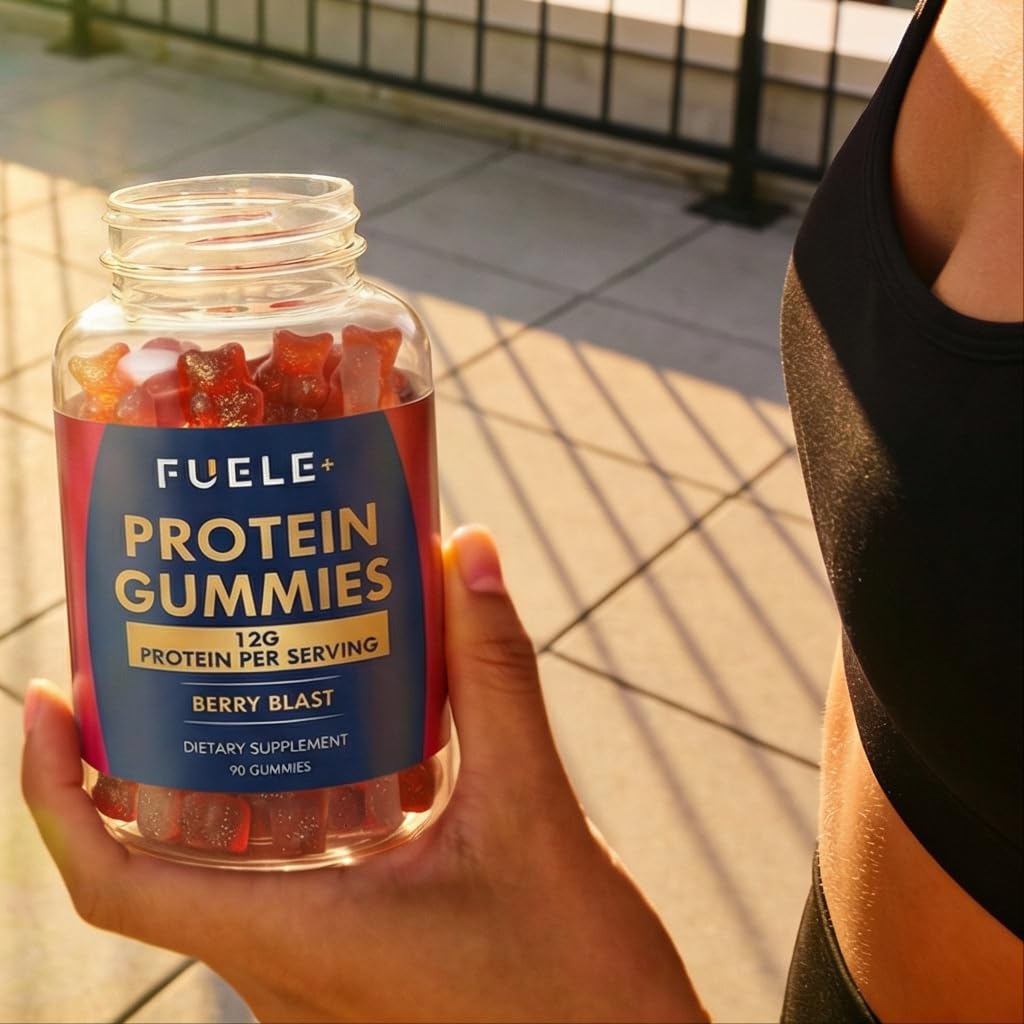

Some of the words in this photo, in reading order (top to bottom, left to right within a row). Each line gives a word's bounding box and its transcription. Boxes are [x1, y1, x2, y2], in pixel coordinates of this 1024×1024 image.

[123, 502, 377, 562] PROTEIN
[114, 556, 393, 618] GUMMIES
[235, 630, 280, 649] 12G
[140, 647, 232, 668] PROTEIN
[239, 650, 279, 667] PER
[288, 636, 379, 664] SERVING
[192, 695, 260, 713] BERRY
[268, 689, 334, 711] BLAST
[183, 739, 246, 755] DIETARY
[250, 733, 349, 755] SUPPLEMENT
[229, 764, 246, 776] 90
[249, 760, 311, 776] GUMMIES
